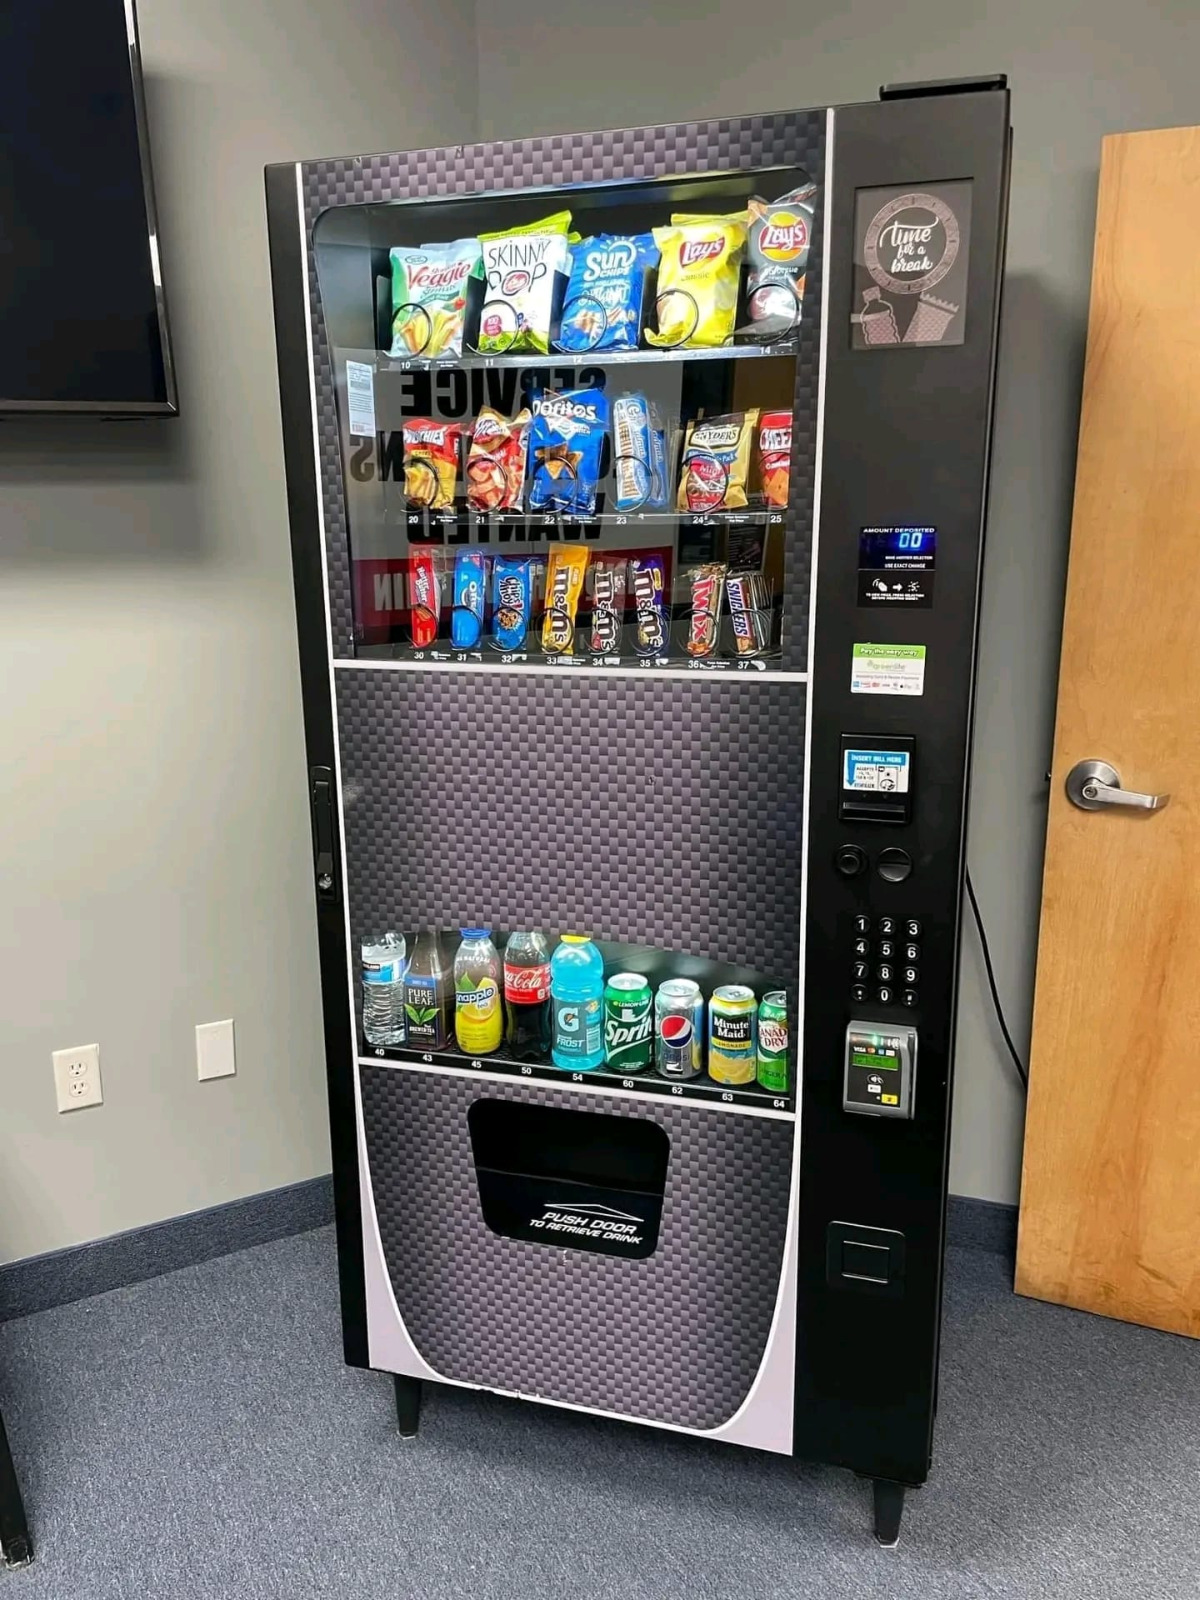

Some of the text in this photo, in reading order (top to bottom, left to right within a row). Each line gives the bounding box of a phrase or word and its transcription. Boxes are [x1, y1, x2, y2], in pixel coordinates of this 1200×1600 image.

[880, 217, 939, 248] time
[896, 243, 927, 259] for a
[583, 248, 635, 281] Sun
[890, 256, 934, 274] break
[407, 261, 471, 290] Veggie
[759, 347, 771, 355] 14
[400, 361, 411, 370] 10
[484, 358, 494, 367] 11
[532, 400, 597, 421] Doritos
[760, 428, 792, 451] CHEE
[408, 515, 419, 524] 20
[475, 515, 485, 524] 21
[544, 516, 555, 525] 22
[616, 516, 627, 525] 23
[692, 516, 704, 524] 24
[770, 515, 782, 524] 25
[469, 581, 478, 612] ORE
[692, 575, 716, 642] TWIX
[727, 582, 748, 636] SNICKERS
[414, 651, 424, 660] 30
[860, 647, 873, 655] Pay
[456, 653, 467, 661] 31
[501, 654, 512, 663] 32
[546, 656, 557, 665] 33
[592, 658, 603, 667] 34
[639, 659, 650, 668] 35
[688, 660, 699, 669] 36
[737, 661, 749, 670] 37
[851, 754, 872, 762] INSERT
[858, 918, 918, 935] 1 2 3
[856, 942, 917, 958] 4 5 6
[856, 965, 916, 981] 7 8 9
[408, 988, 433, 998] PURE
[880, 989, 889, 1001] 0
[408, 996, 433, 1005] LEAF
[558, 1007, 579, 1032] G
[714, 1016, 749, 1029] Minute
[605, 1015, 652, 1046] Sprit
[718, 1028, 745, 1038] Maid
[761, 1028, 788, 1037] ANAD
[556, 1038, 585, 1047] FROST
[764, 1038, 785, 1047] DRY
[374, 1048, 385, 1057] 40
[422, 1053, 433, 1063] 43
[471, 1060, 482, 1069] 45
[521, 1066, 532, 1075] 50
[572, 1073, 584, 1082] 54
[623, 1079, 634, 1089] 60
[671, 1086, 683, 1095] 62
[722, 1092, 734, 1102] 63
[773, 1099, 785, 1109] 64
[541, 1211, 637, 1235] PUSH DOOR
[528, 1219, 644, 1245] TO RETRIEVE DRINK
